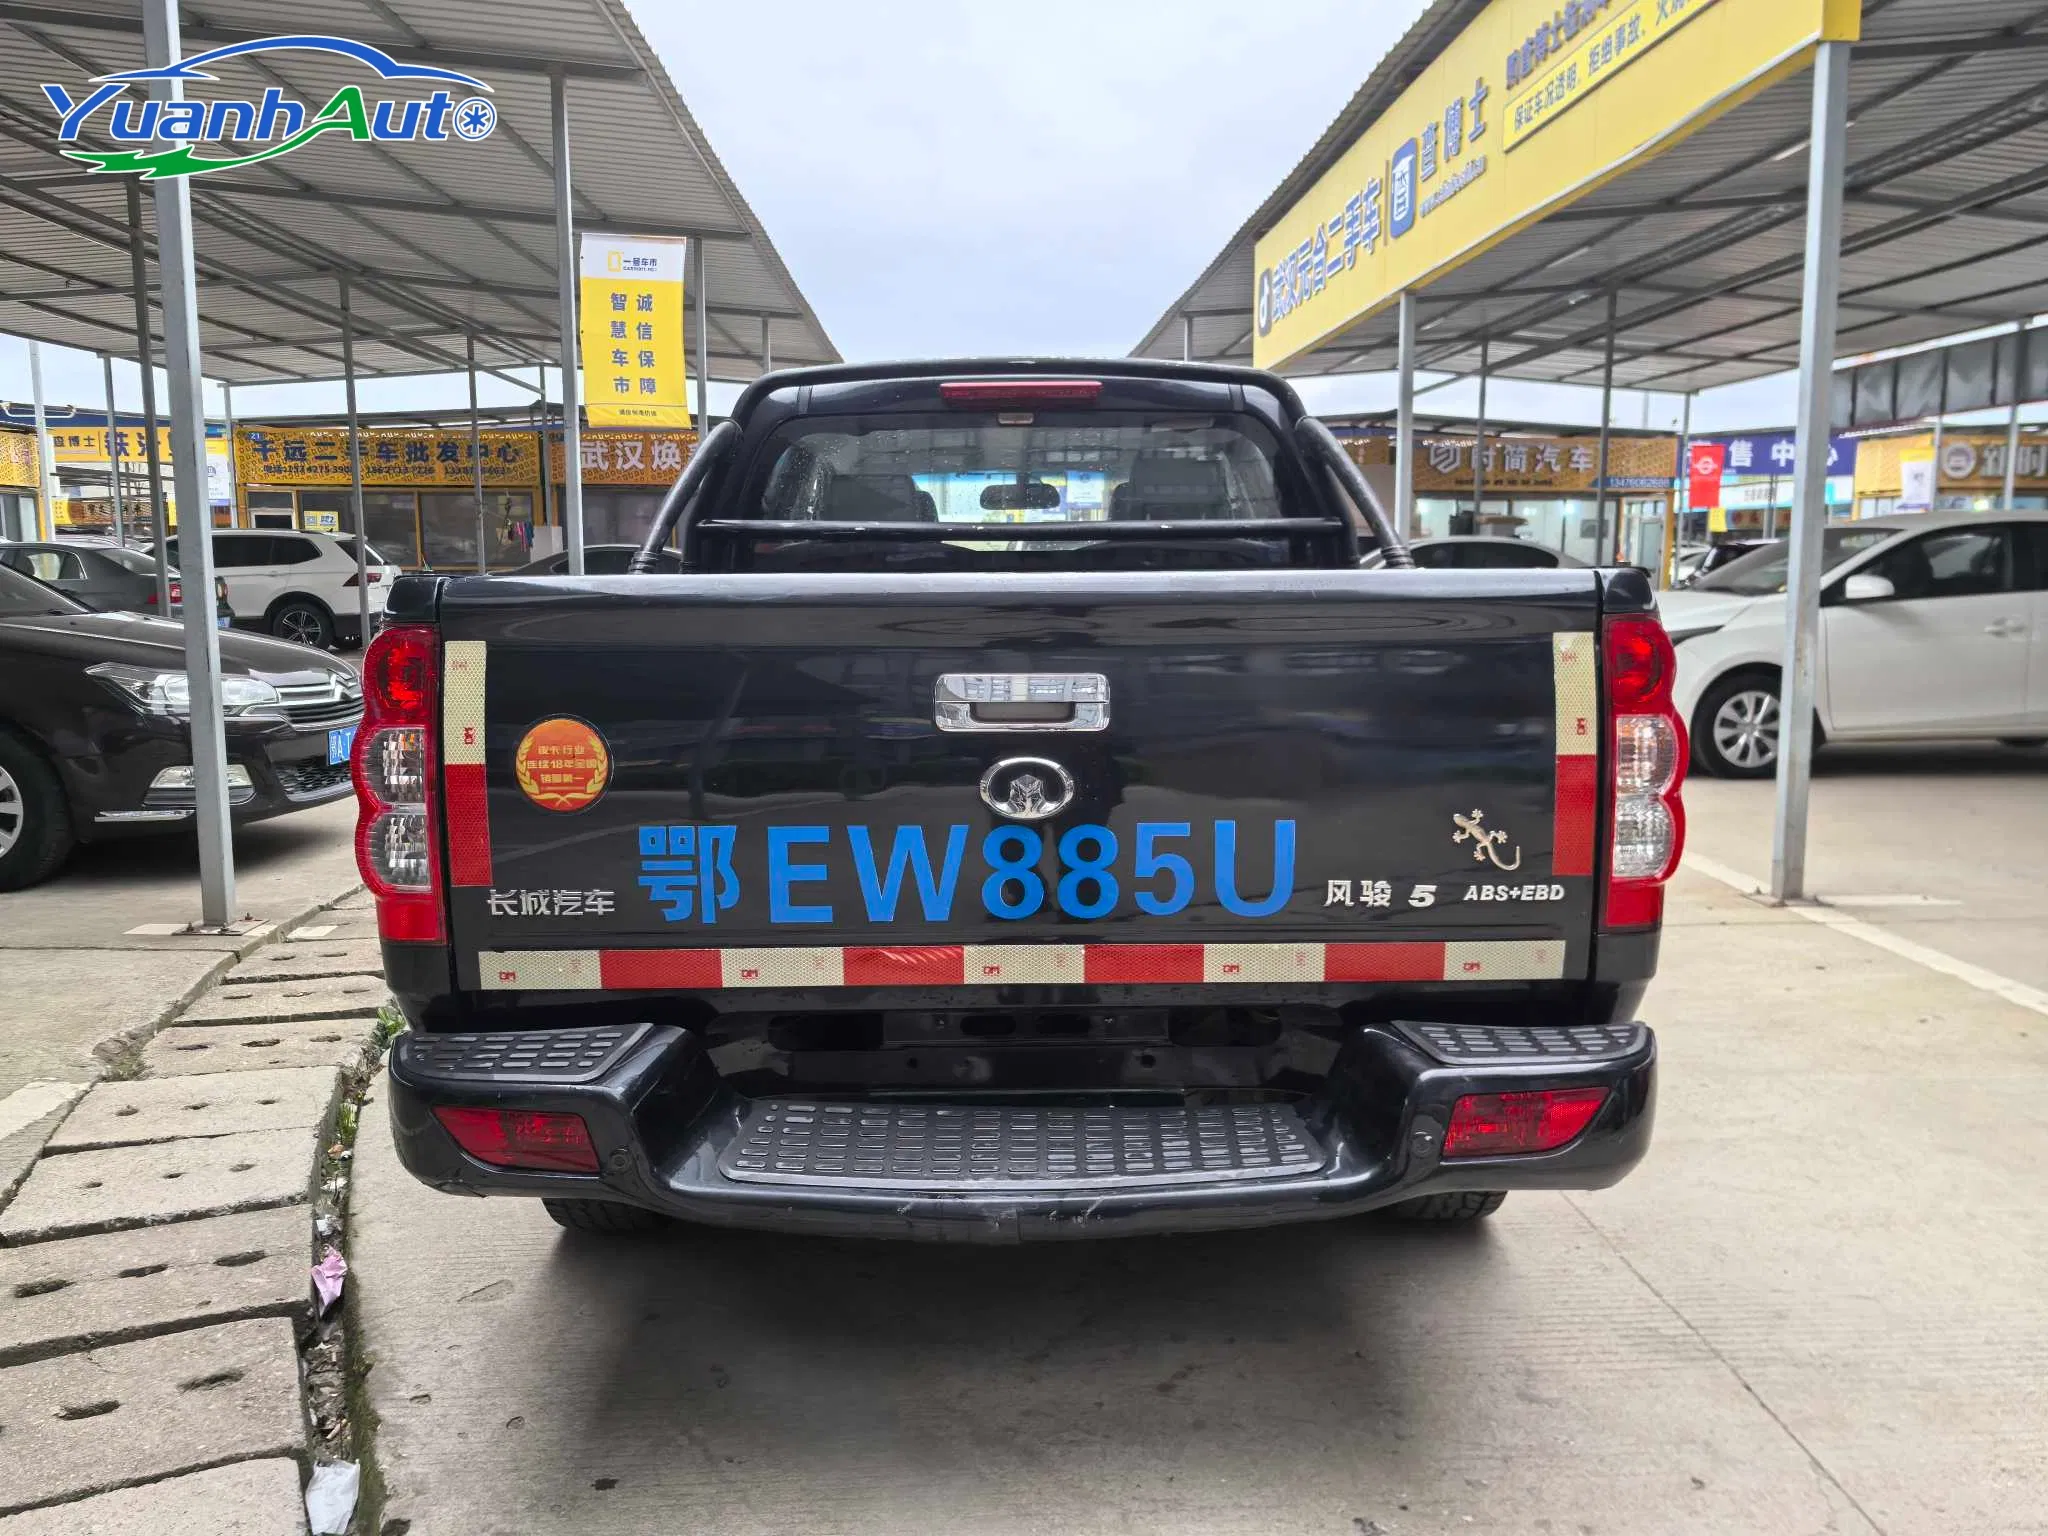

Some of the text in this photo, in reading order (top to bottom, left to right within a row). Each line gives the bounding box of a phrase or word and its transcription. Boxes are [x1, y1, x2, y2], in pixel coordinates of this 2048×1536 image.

[1420, 78, 1488, 183] 查博士
[610, 292, 631, 395] 智慧车市
[636, 293, 657, 396] 诚信保障
[487, 888, 616, 917] 长城汽车
[638, 819, 1296, 924] 鄂EW885U
[1324, 879, 1438, 908] 风骏 5
[1462, 883, 1566, 903] ABS+EBD
